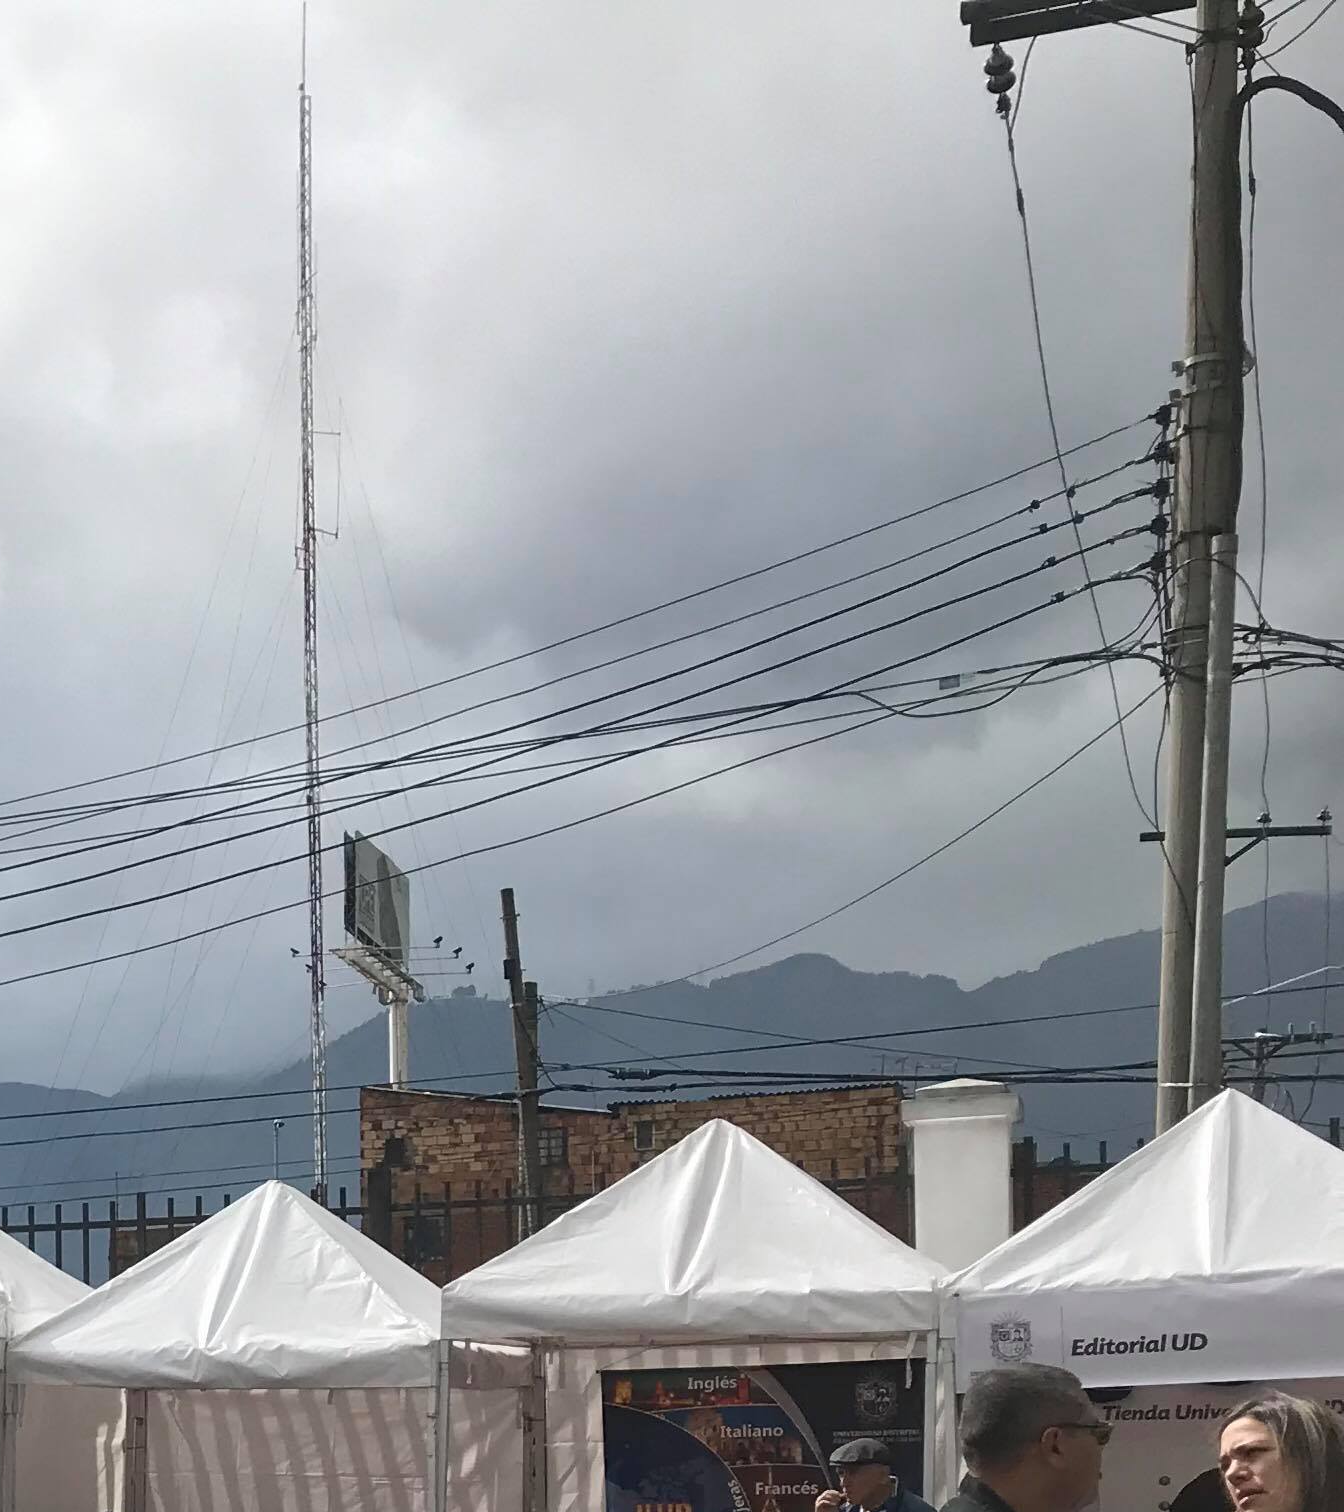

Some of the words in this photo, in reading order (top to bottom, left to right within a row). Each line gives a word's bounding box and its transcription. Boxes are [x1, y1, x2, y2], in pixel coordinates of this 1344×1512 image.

[1071, 1334, 1166, 1356] Editorial
[1171, 1333, 1208, 1351] UD
[687, 1376, 737, 1393] Inglés
[1102, 1404, 1170, 1421] Tienda
[1175, 1404, 1231, 1421] Unive
[720, 1424, 784, 1439] Italiano
[755, 1480, 818, 1495] Francés
